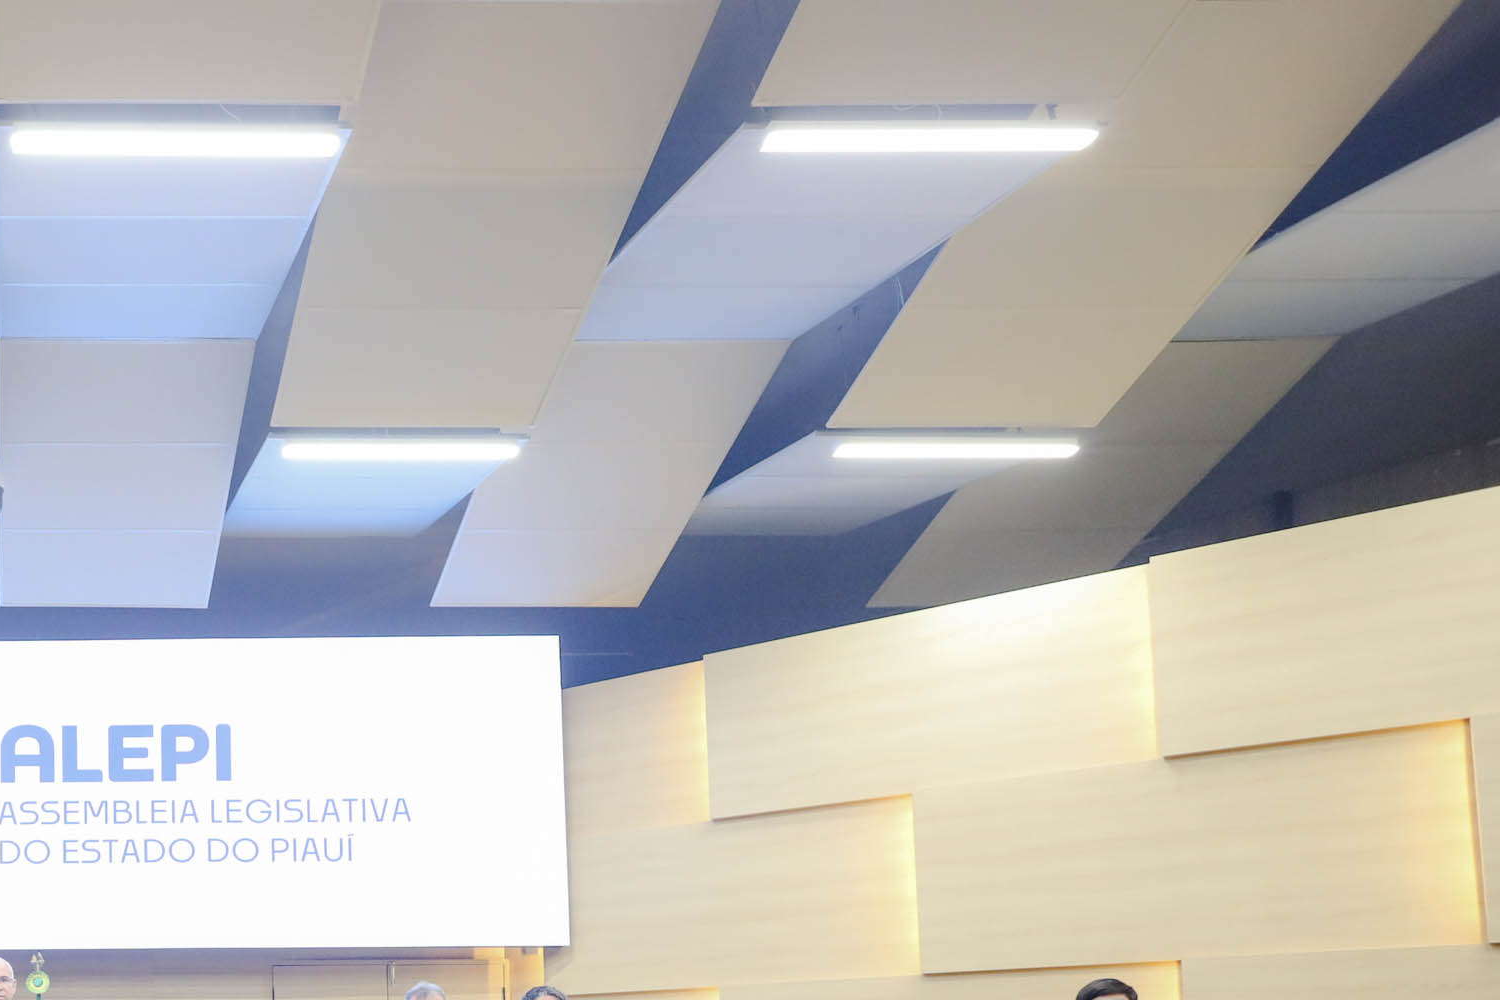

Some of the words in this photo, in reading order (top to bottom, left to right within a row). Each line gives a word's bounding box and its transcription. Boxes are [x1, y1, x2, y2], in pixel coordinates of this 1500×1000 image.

[0, 723, 233, 783] ALEPI
[210, 797, 412, 824] LEGISLATIVA
[0, 839, 51, 865] DO
[62, 837, 196, 864] ESTADO
[207, 837, 260, 863] DO
[271, 833, 355, 863] PIAUÍ
